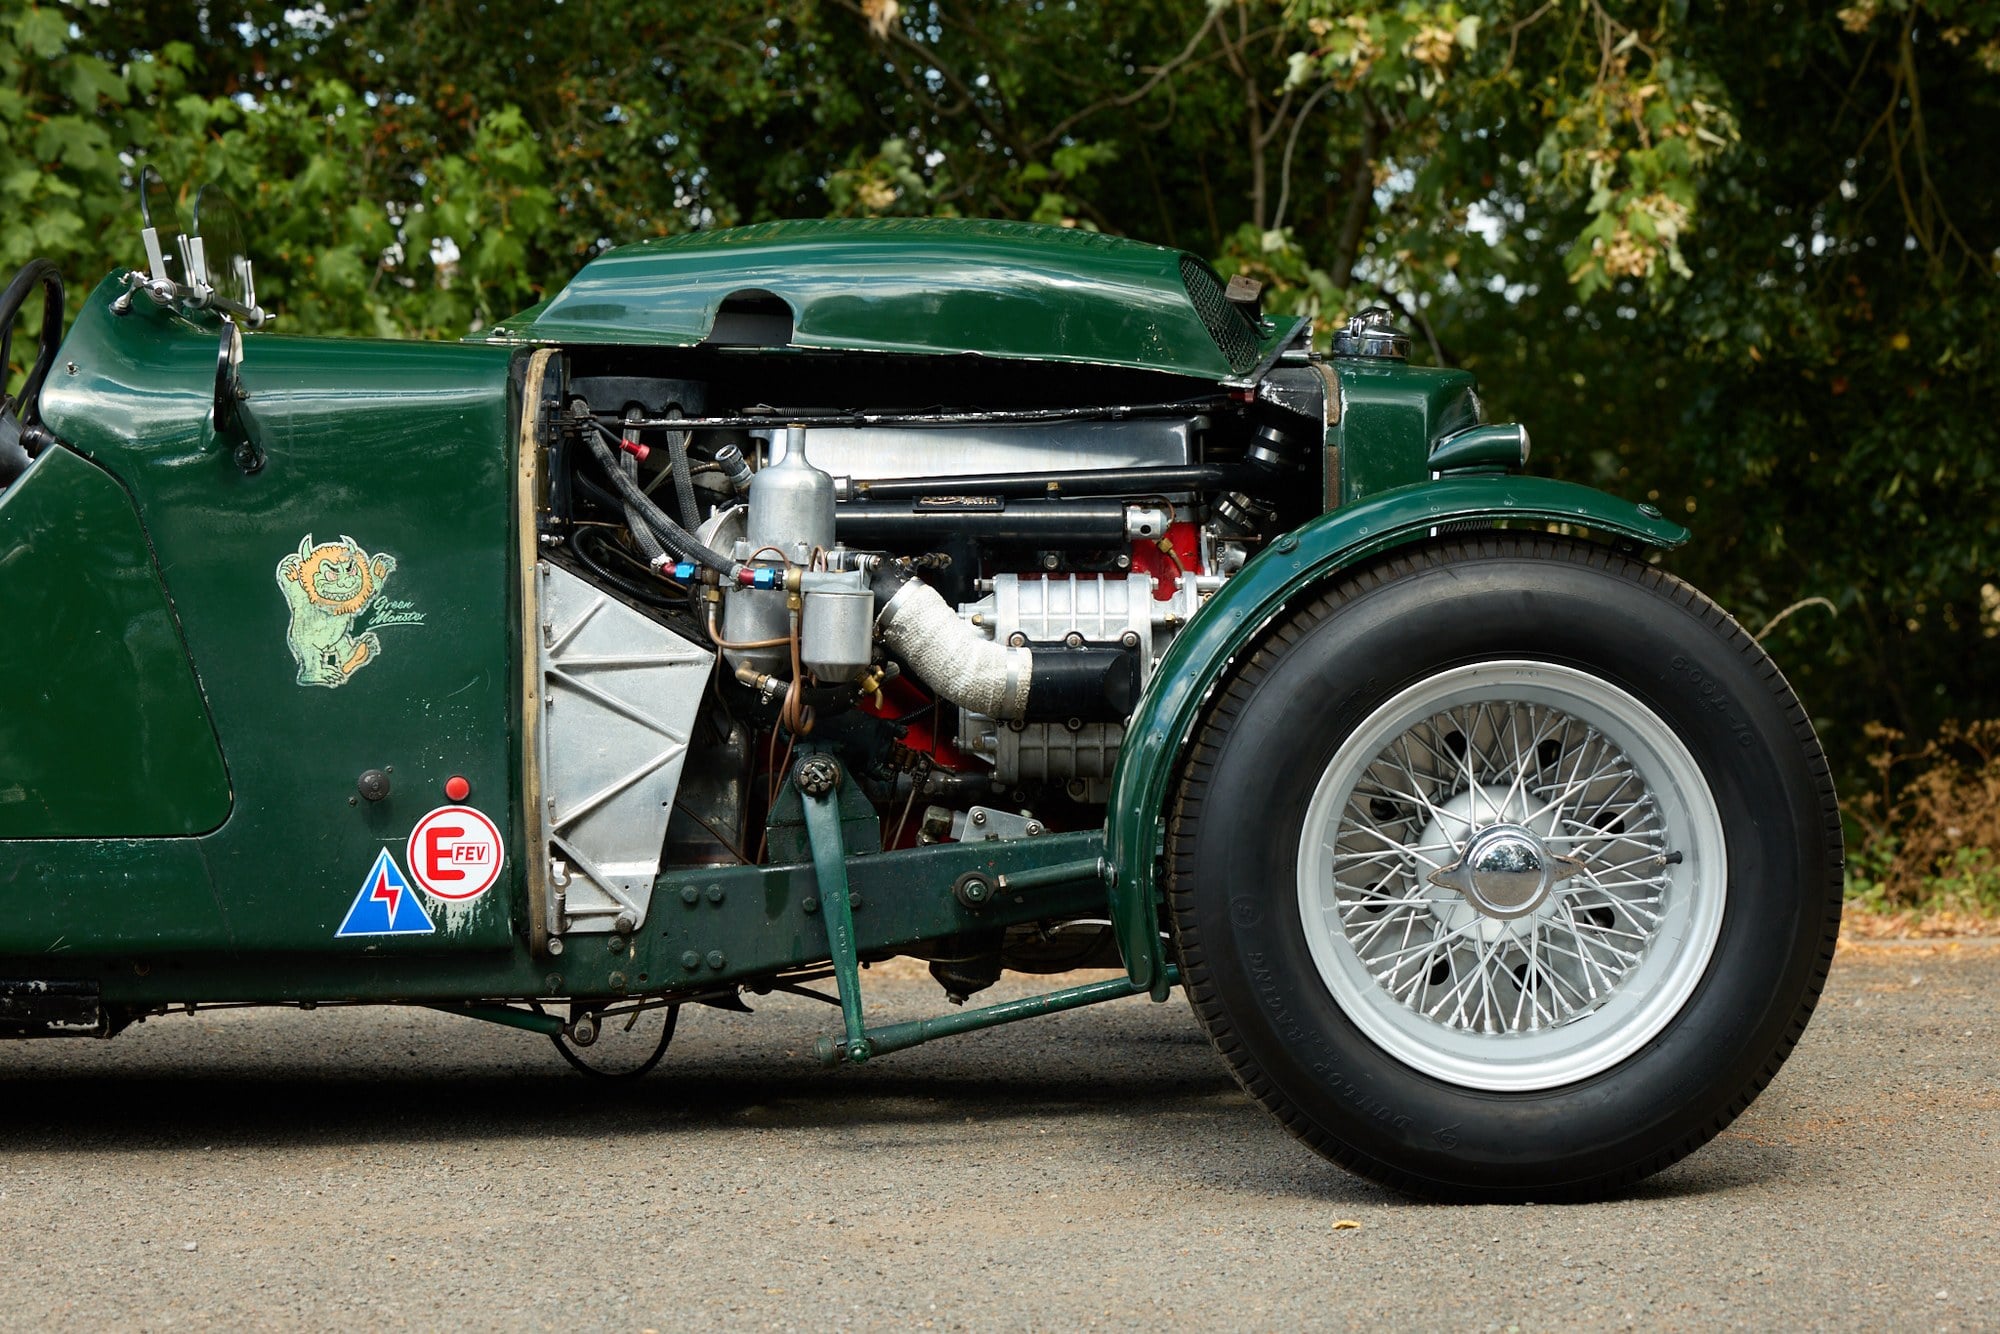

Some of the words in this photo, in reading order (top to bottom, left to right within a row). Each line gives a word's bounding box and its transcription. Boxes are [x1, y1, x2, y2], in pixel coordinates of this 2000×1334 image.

[368, 609, 427, 625] Monster
[373, 595, 415, 615] Green
[426, 826, 465, 880] E
[455, 846, 486, 861] FEV
[1248, 952, 1304, 1041] RACING
[1312, 1062, 1414, 1130] DUNLOP
